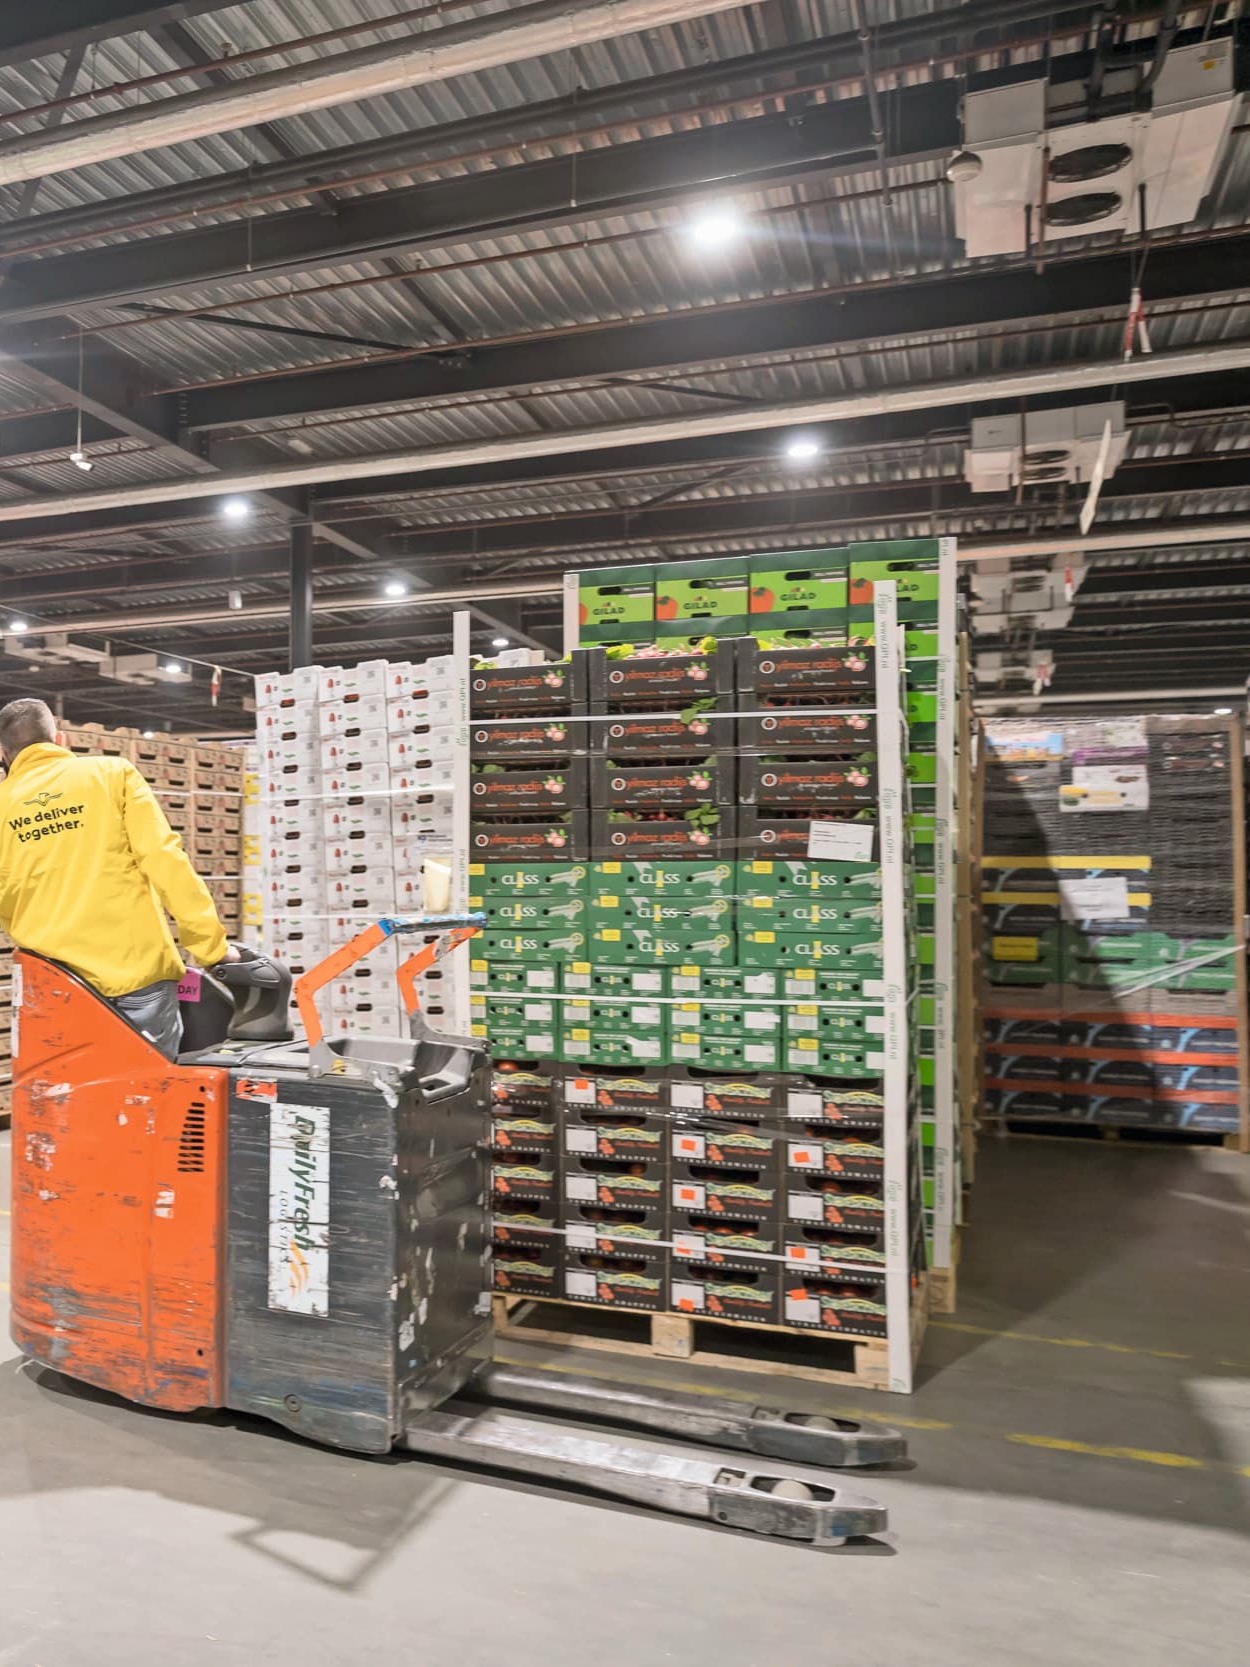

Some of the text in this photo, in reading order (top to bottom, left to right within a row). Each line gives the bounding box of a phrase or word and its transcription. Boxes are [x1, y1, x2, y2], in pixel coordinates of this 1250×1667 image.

[897, 584, 919, 593] LAD
[780, 592, 816, 602] GILAD
[593, 606, 625, 616] GILAD
[683, 601, 718, 610] GILAD
[8, 805, 84, 831] We deliver
[18, 820, 84, 843] together.
[289, 1115, 317, 1251] DailyFresh
[280, 1190, 289, 1263] LOGSTICS
